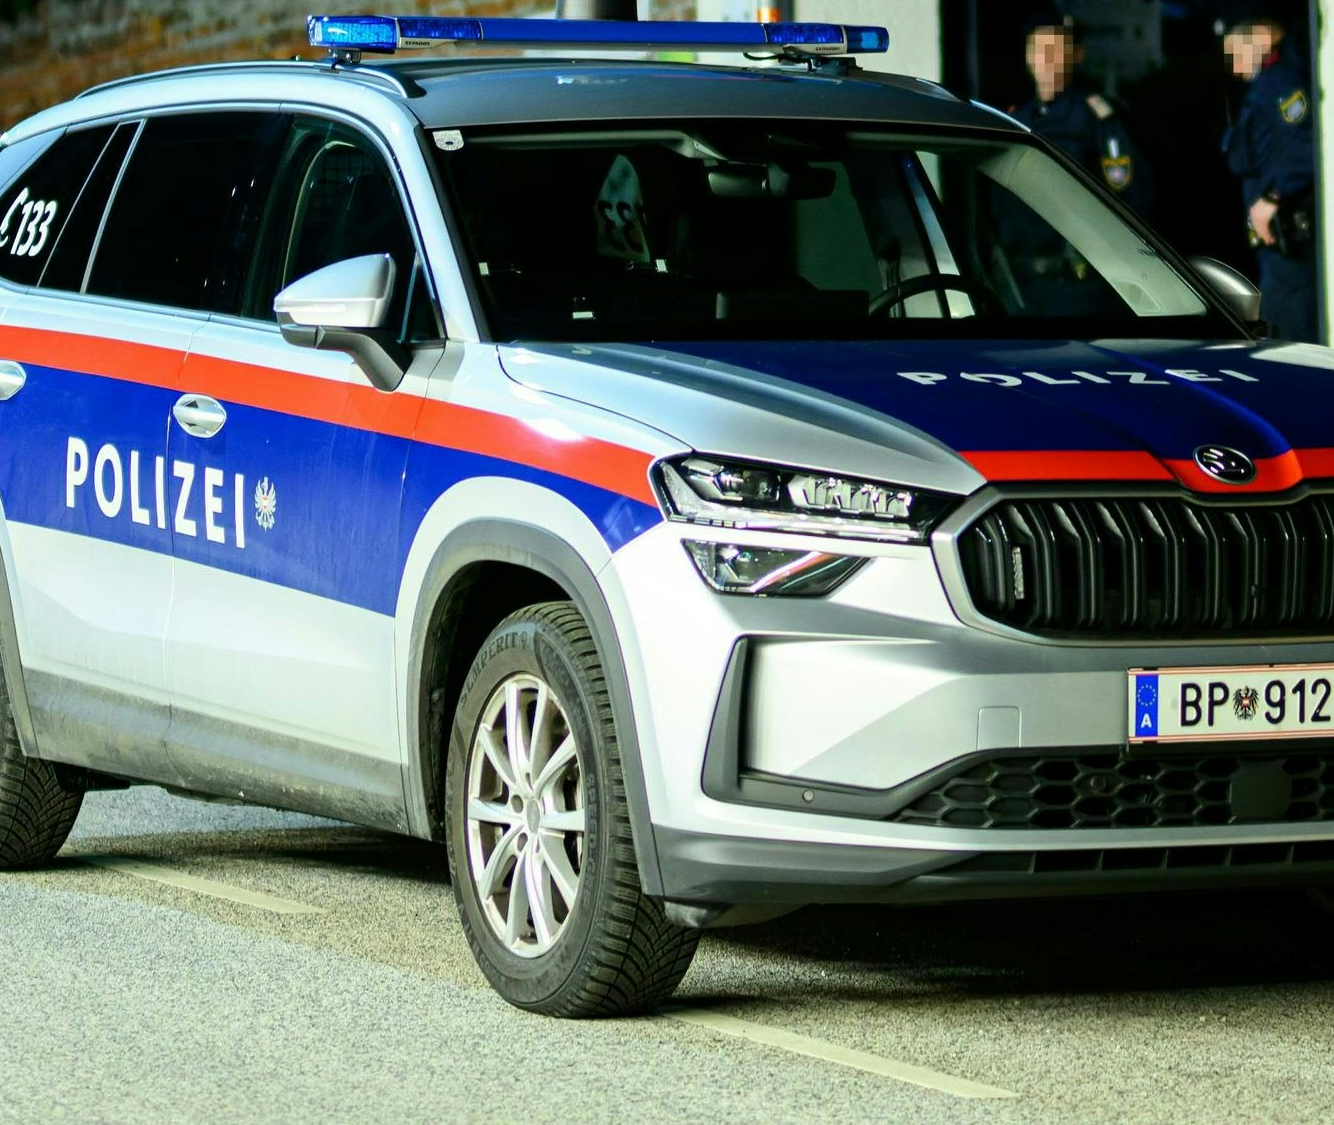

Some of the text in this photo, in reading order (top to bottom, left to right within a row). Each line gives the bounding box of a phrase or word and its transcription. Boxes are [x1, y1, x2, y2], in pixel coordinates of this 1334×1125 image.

[9, 199, 58, 257] 133
[896, 368, 1260, 388] POLIZEI
[65, 435, 246, 549] POLIZEI
[1140, 713, 1153, 728] A
[1180, 681, 1230, 727] BP
